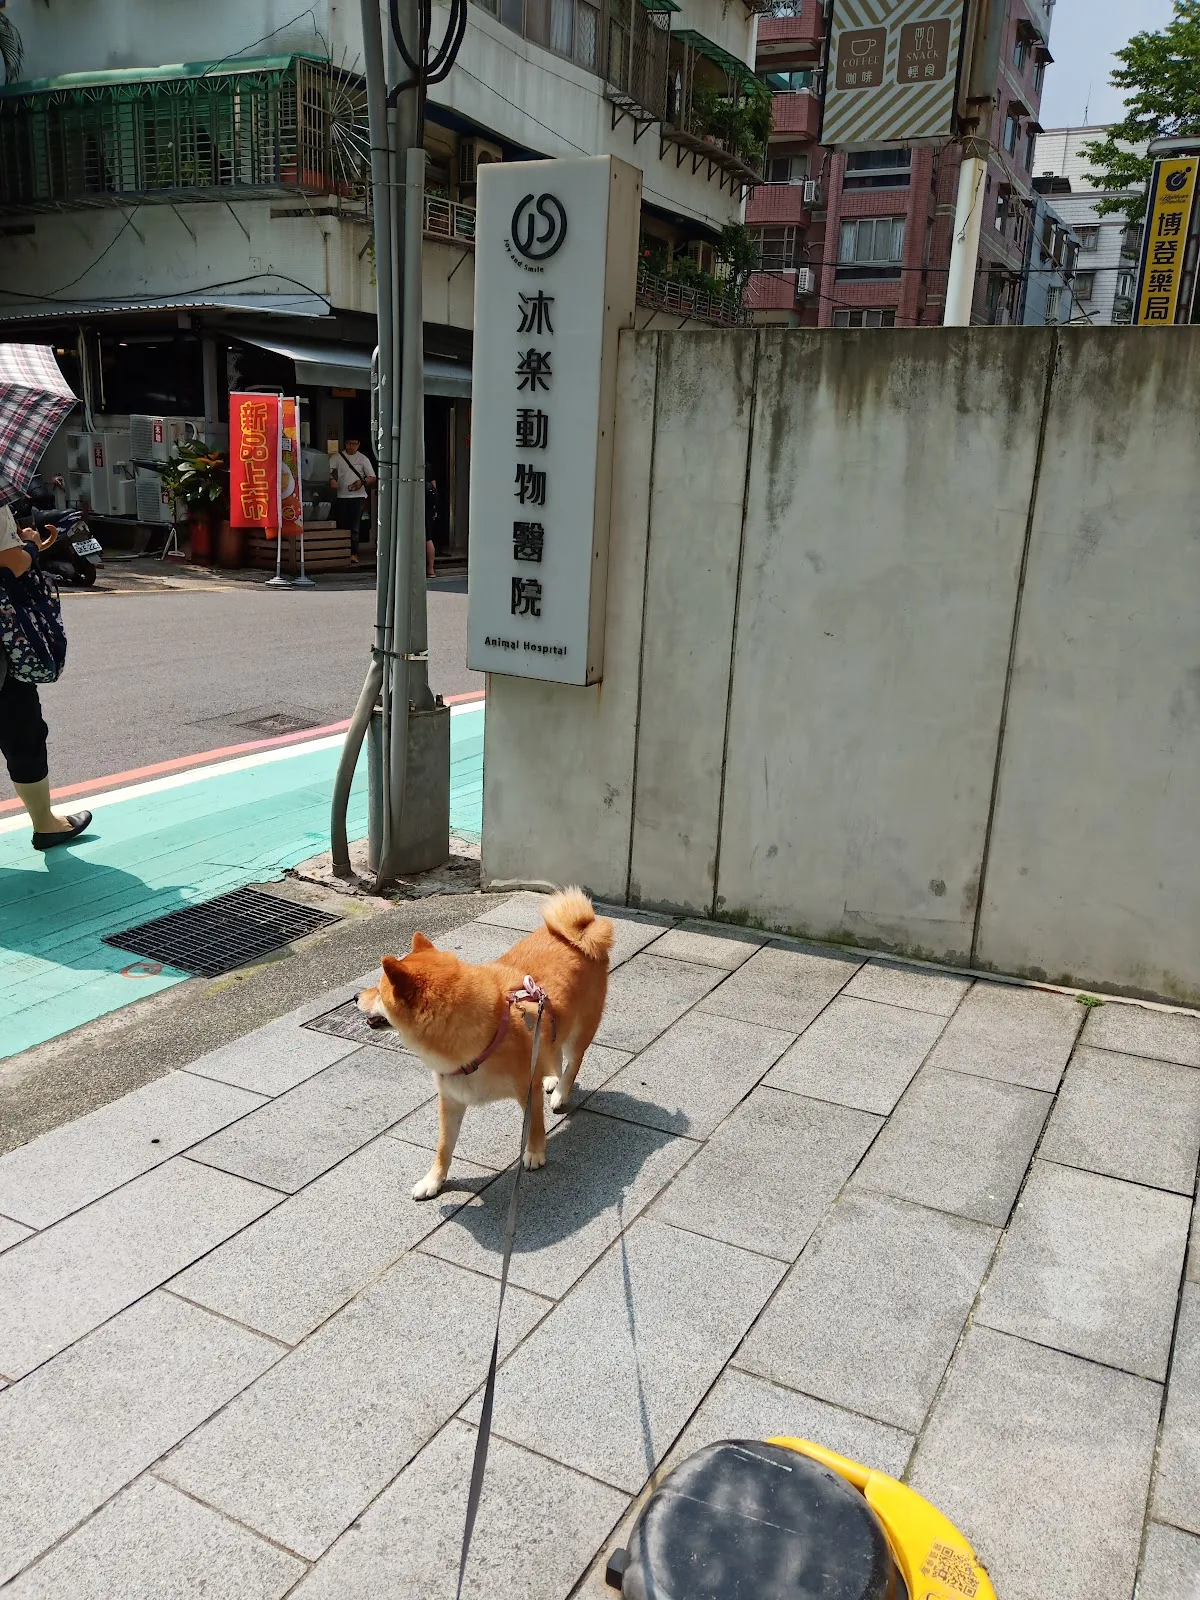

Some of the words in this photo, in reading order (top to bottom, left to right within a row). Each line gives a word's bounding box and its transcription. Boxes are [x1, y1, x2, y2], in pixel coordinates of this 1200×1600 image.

[843, 56, 880, 68] COFFEE
[906, 50, 939, 61] SNACK
[845, 71, 873, 85] 咖啡
[907, 64, 936, 79] 輕食
[510, 255, 523, 267] and
[1144, 212, 1183, 320] 博登藥局
[240, 401, 268, 520] 新品上市
[484, 636, 519, 650] Animal
[523, 641, 567, 655] Hospital
